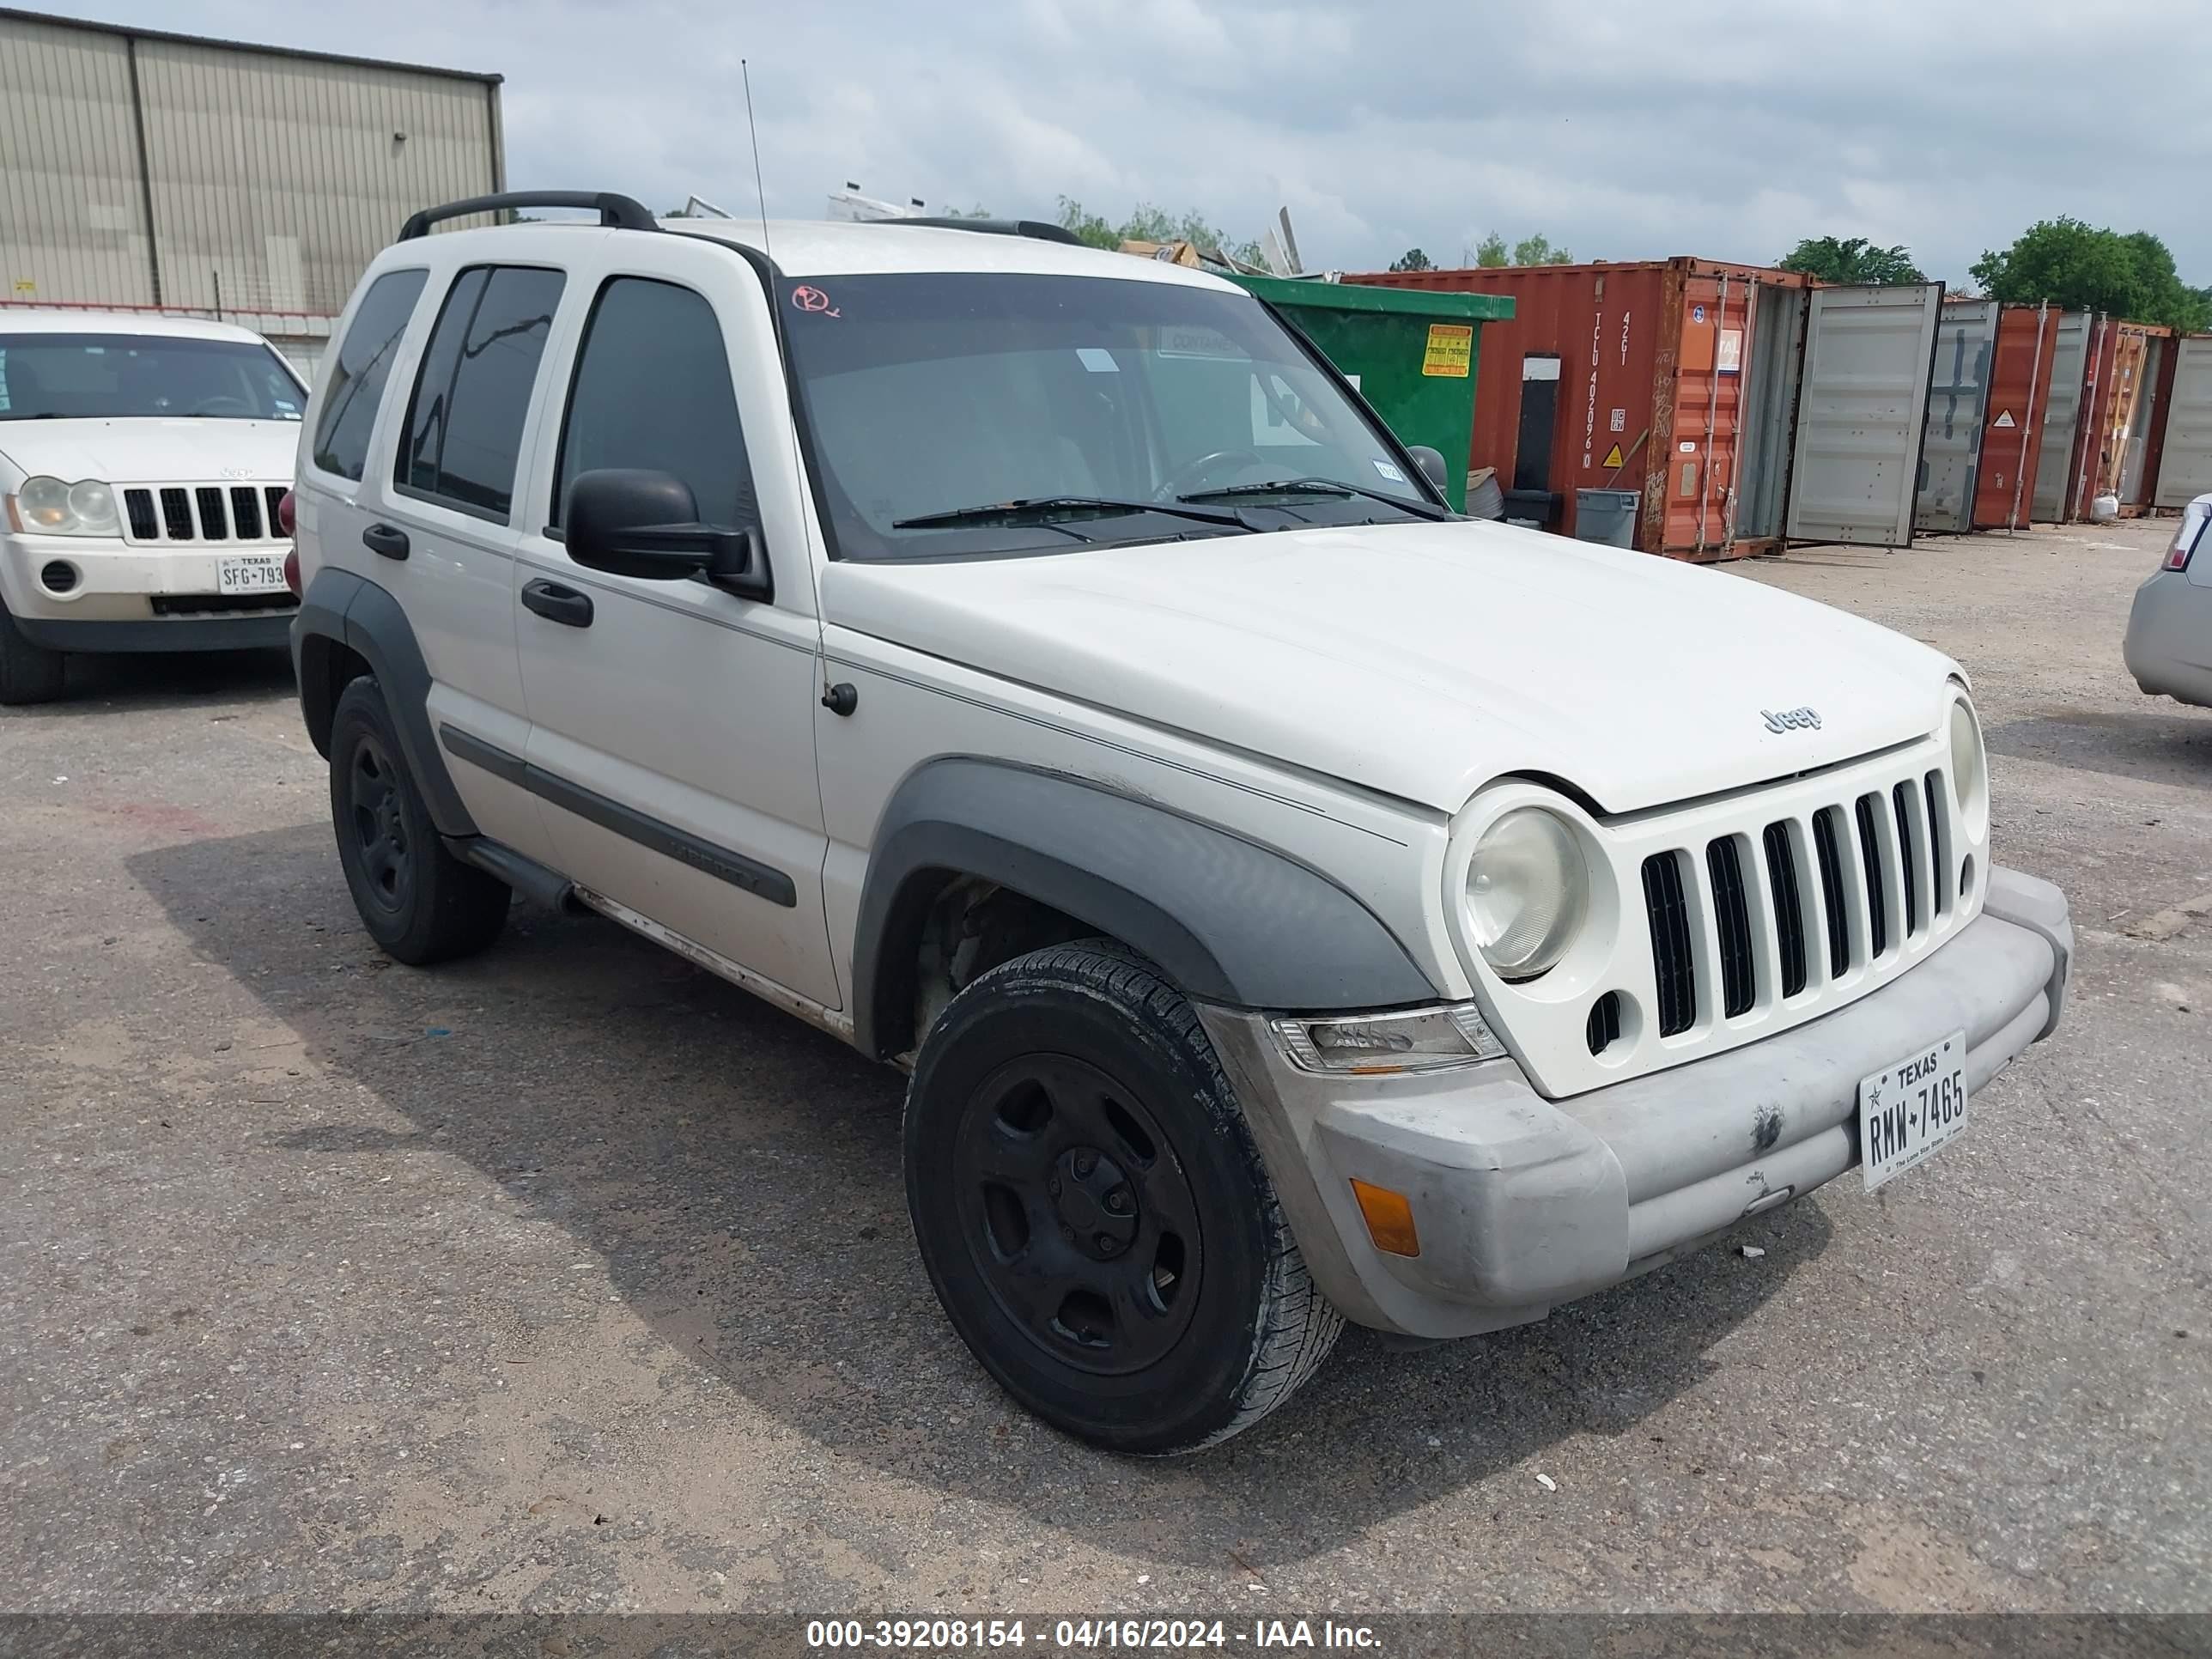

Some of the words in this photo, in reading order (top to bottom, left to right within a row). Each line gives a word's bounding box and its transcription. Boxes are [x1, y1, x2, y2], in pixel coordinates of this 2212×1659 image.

[1592, 313, 1601, 366] TCLU
[1585, 370, 1597, 449] 402096
[258, 566, 284, 585] 793
[1759, 707, 1822, 734] Jeep
[1898, 1052, 1937, 1090] TEXAS
